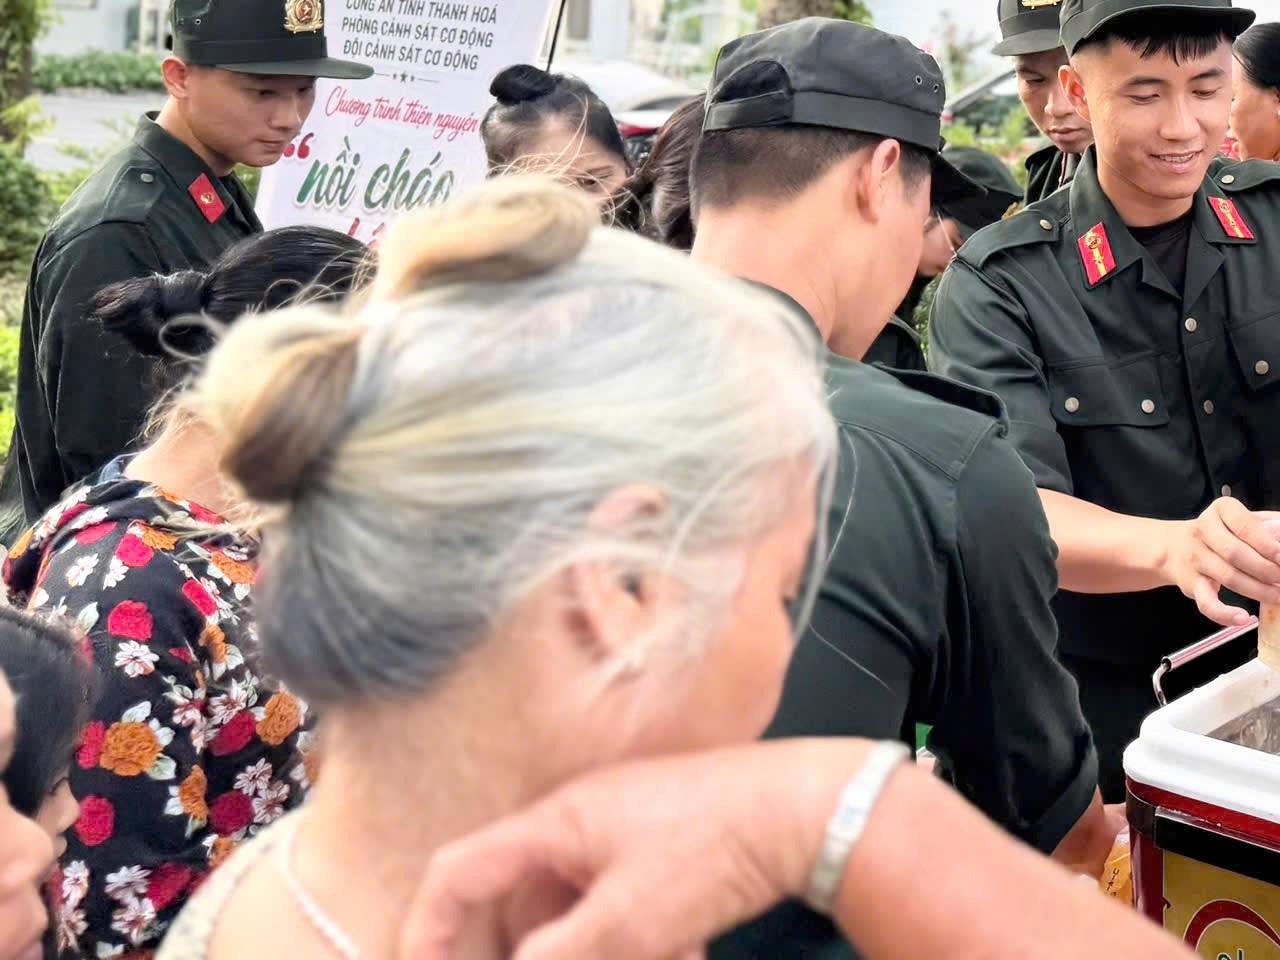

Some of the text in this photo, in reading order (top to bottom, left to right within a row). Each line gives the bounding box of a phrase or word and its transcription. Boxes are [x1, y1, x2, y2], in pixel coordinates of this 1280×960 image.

[428, 1, 469, 21] THANH
[471, 3, 498, 24] HOÁ
[341, 16, 494, 50] PHÒNG CẢNH SÁT CƠ ĐỘNG
[343, 37, 479, 71] ĐỘI CẢNH SÁT CƠ ĐỘNG
[325, 85, 481, 142] Chương trình thiện nguyện
